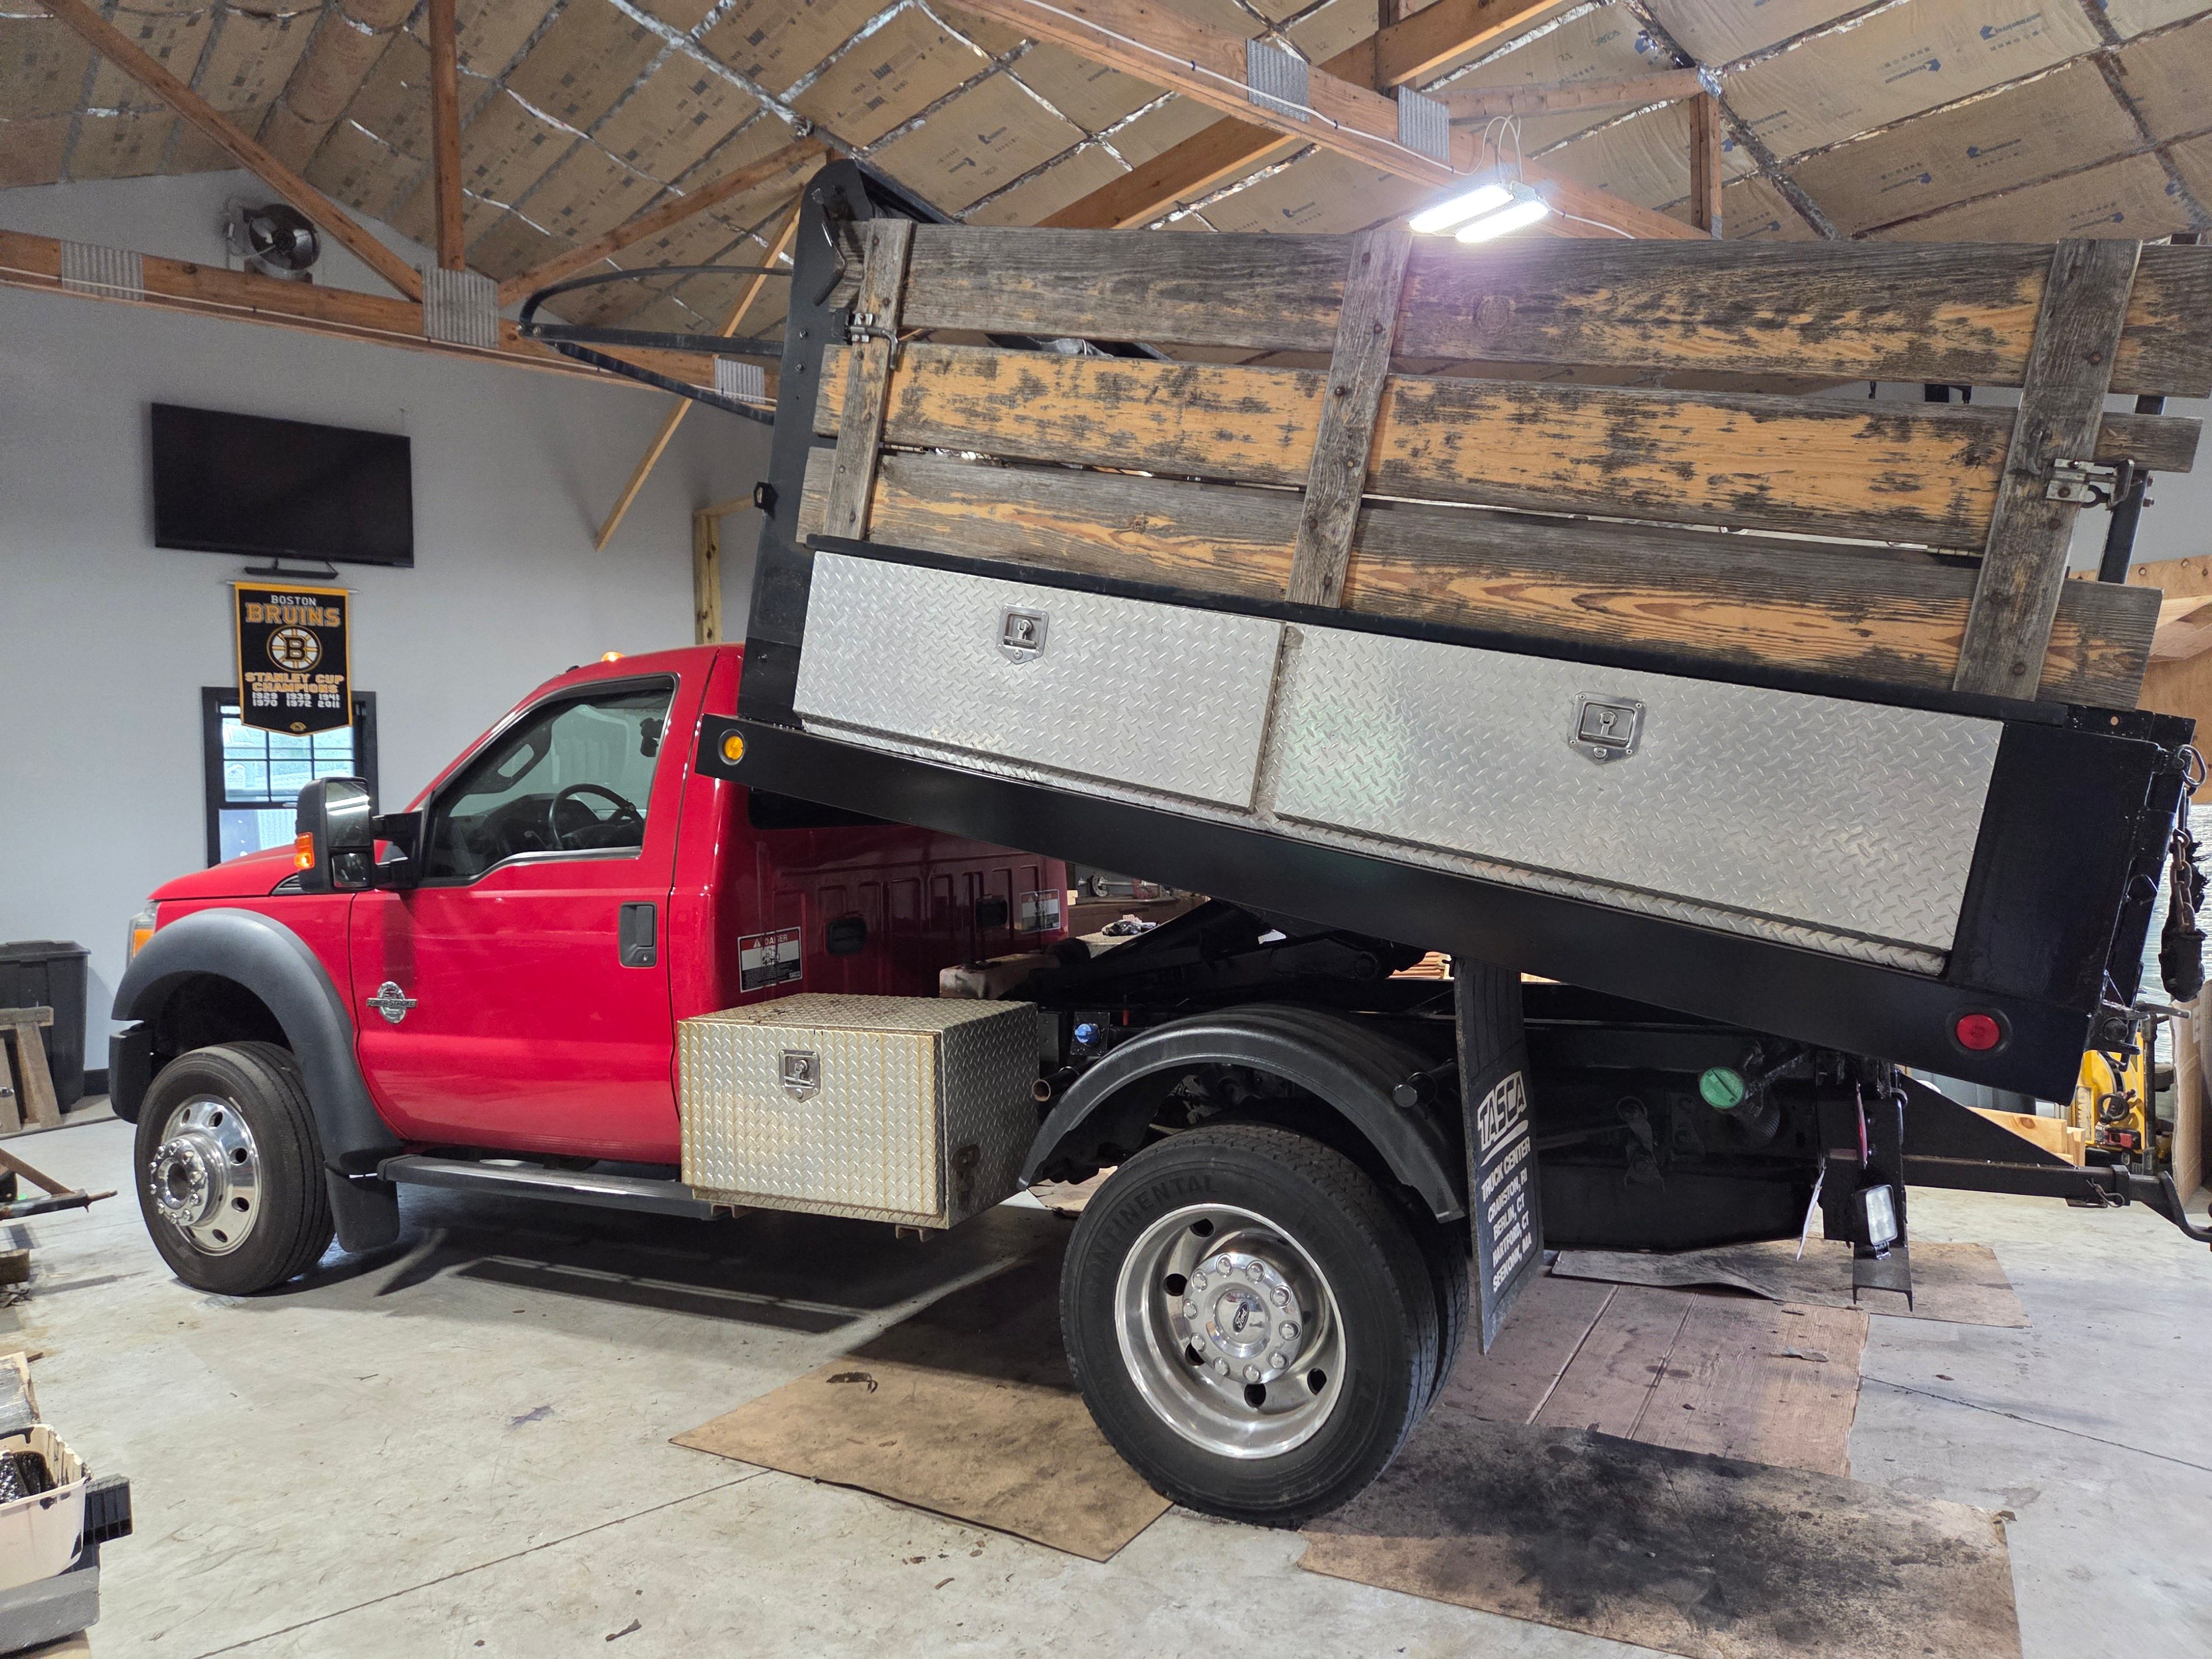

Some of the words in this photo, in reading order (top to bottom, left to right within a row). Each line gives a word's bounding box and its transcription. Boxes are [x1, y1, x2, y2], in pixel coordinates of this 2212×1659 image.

[246, 603, 341, 627] BRUINS
[271, 594, 316, 606] BOSTON
[284, 635, 307, 661] B
[244, 672, 311, 684] STANLEY
[315, 674, 345, 684] CUP
[252, 682, 338, 693] CHAMPIONS
[764, 934, 788, 946] DAER
[1478, 1071, 1527, 1151] TASCA
[1481, 1162, 1504, 1202] TRUCK
[1504, 1136, 1531, 1175] CENTER
[1488, 1176, 1521, 1223] CRANSTON,
[1520, 1167, 1527, 1185] RI
[1493, 1204, 1517, 1241] BERLIN,
[1516, 1192, 1525, 1212] CT
[1084, 1175, 1219, 1298] CONTINENTAL
[1493, 1222, 1522, 1268] HARTFORD,
[1522, 1210, 1529, 1229] CT
[1493, 1244, 1522, 1292] SEEKONK,
[1522, 1232, 1532, 1254] MA
[1235, 1307, 1248, 1328] Ford
